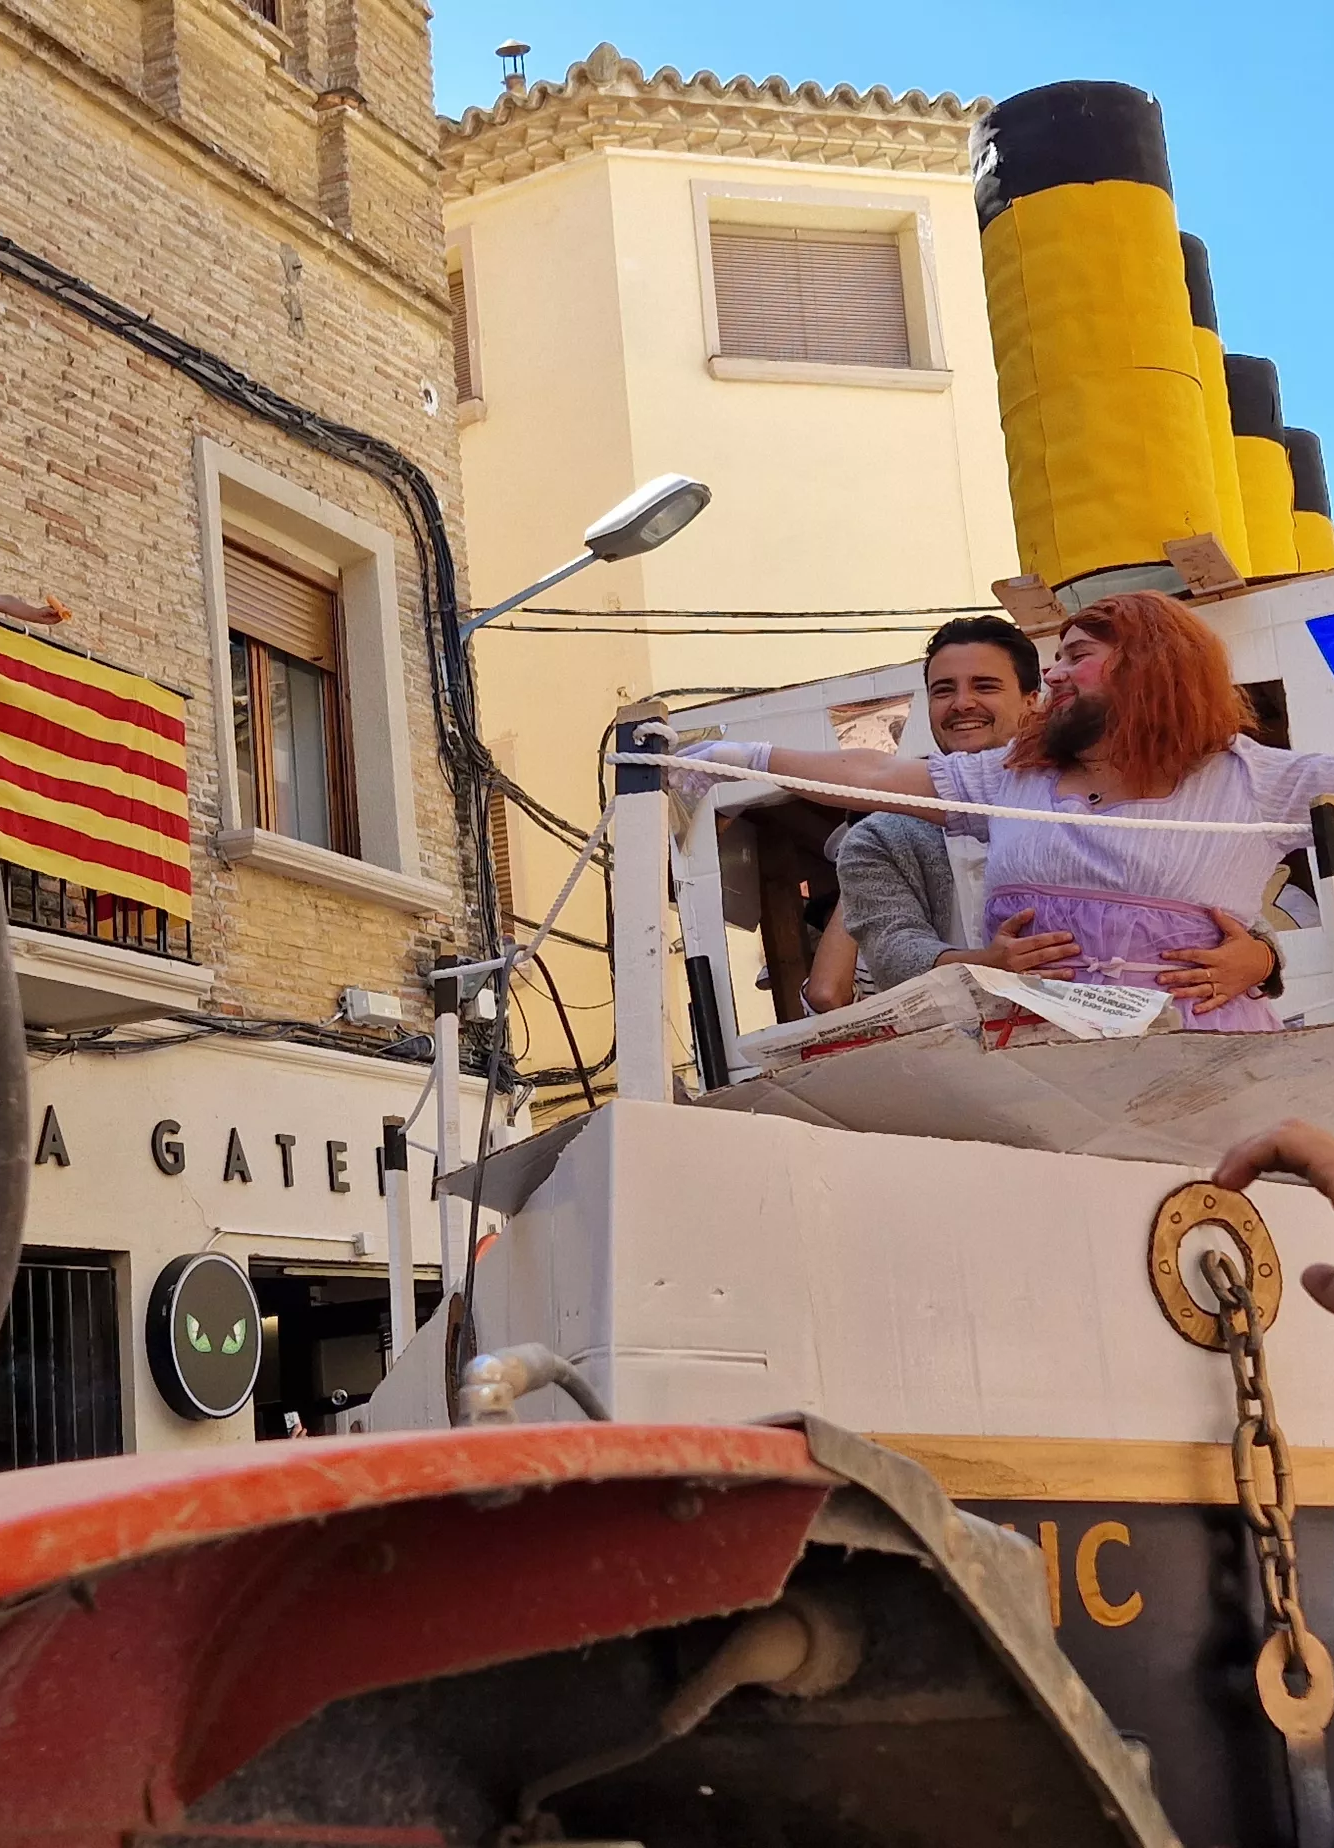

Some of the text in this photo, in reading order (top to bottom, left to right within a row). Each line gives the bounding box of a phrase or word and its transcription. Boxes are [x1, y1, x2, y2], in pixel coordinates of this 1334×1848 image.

[35, 1104, 439, 1202] A GATE
[1003, 1520, 1144, 1628] IC
